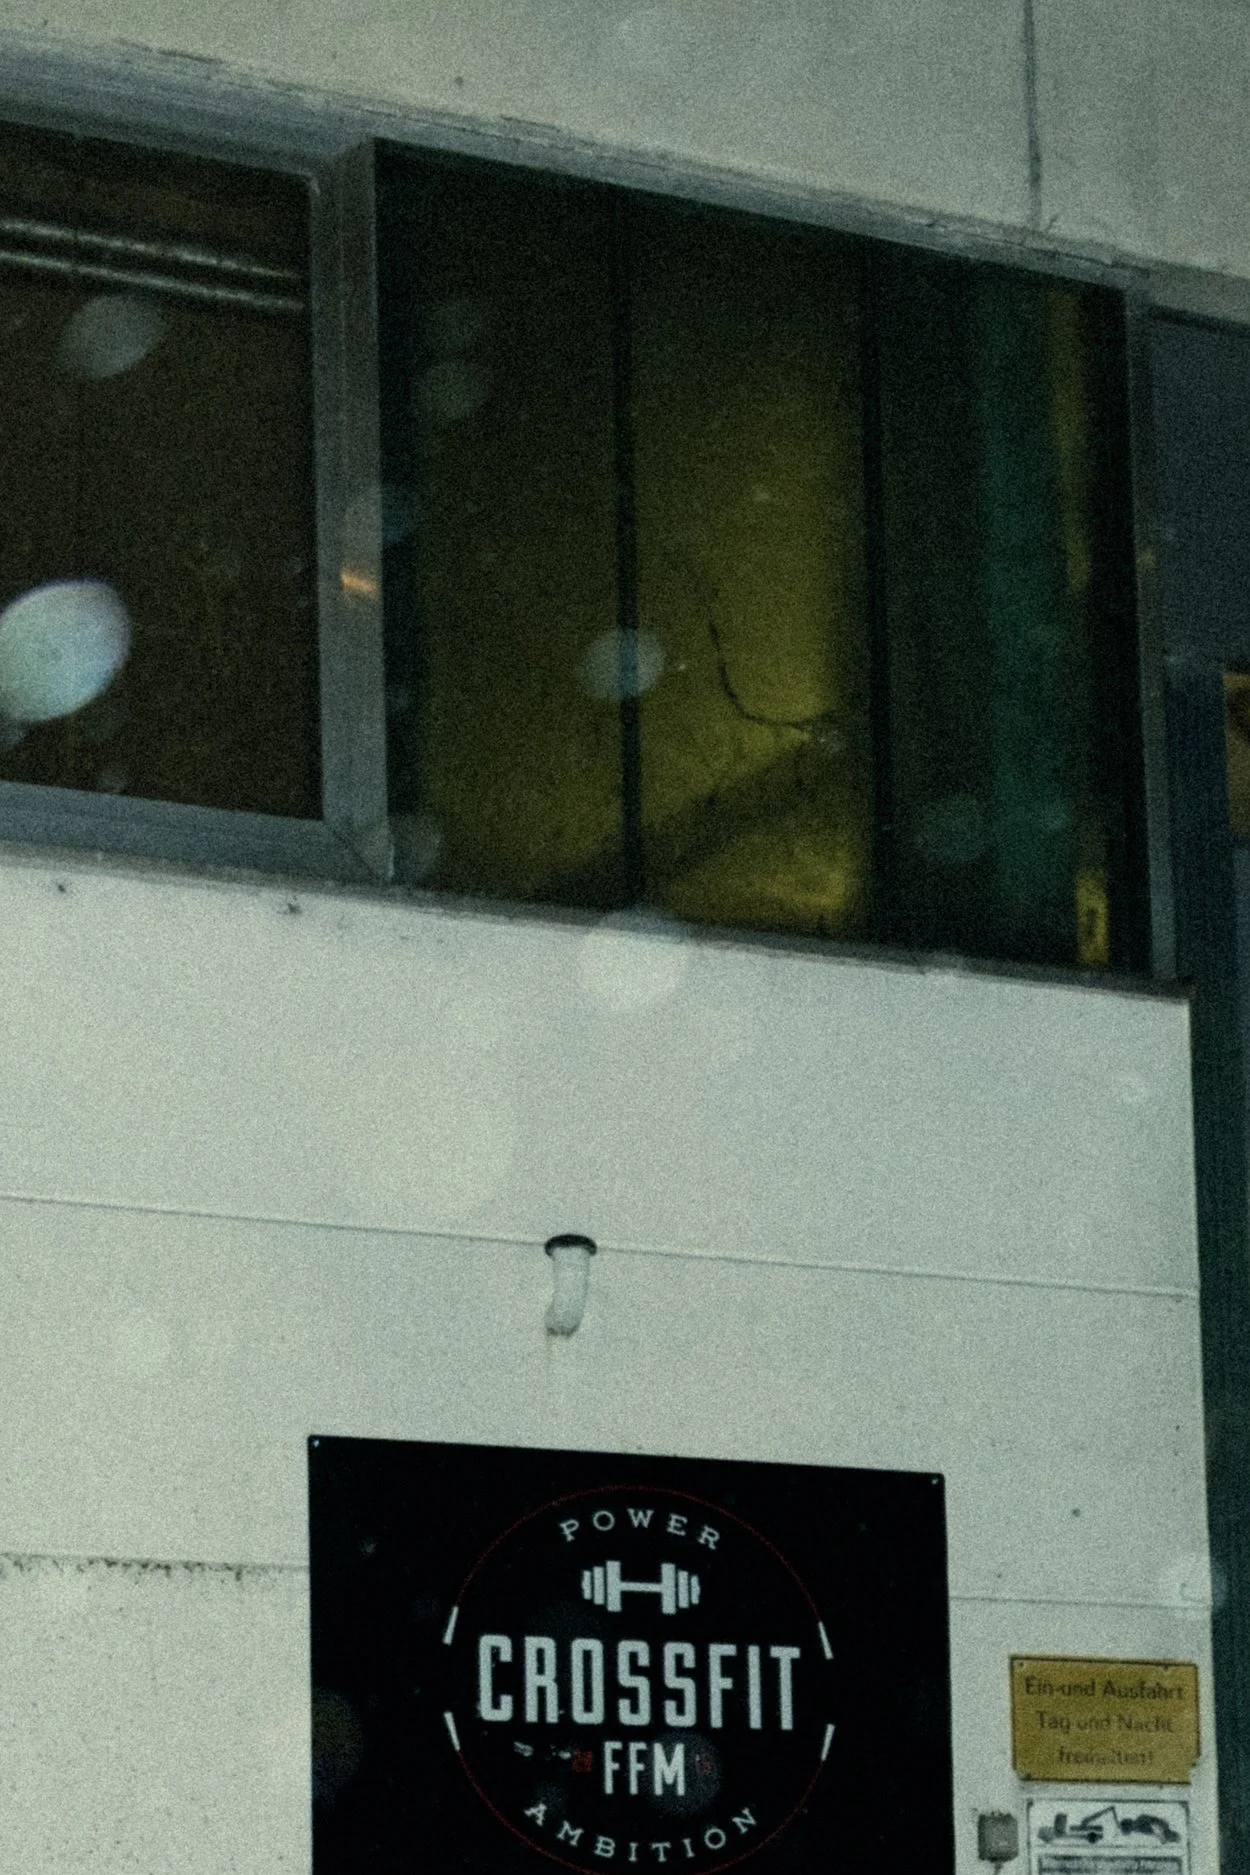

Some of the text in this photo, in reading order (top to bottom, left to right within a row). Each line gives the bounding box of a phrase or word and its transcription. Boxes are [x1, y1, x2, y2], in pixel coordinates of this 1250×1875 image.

[558, 1507, 722, 1550] POWER
[478, 1633, 801, 1731] CROSSFIT
[1103, 1679, 1184, 1700] Ausfahrt
[1036, 1711, 1173, 1735] Tag und Nacht
[603, 1741, 687, 1796] FFM
[524, 1802, 759, 1864] AMBITION
